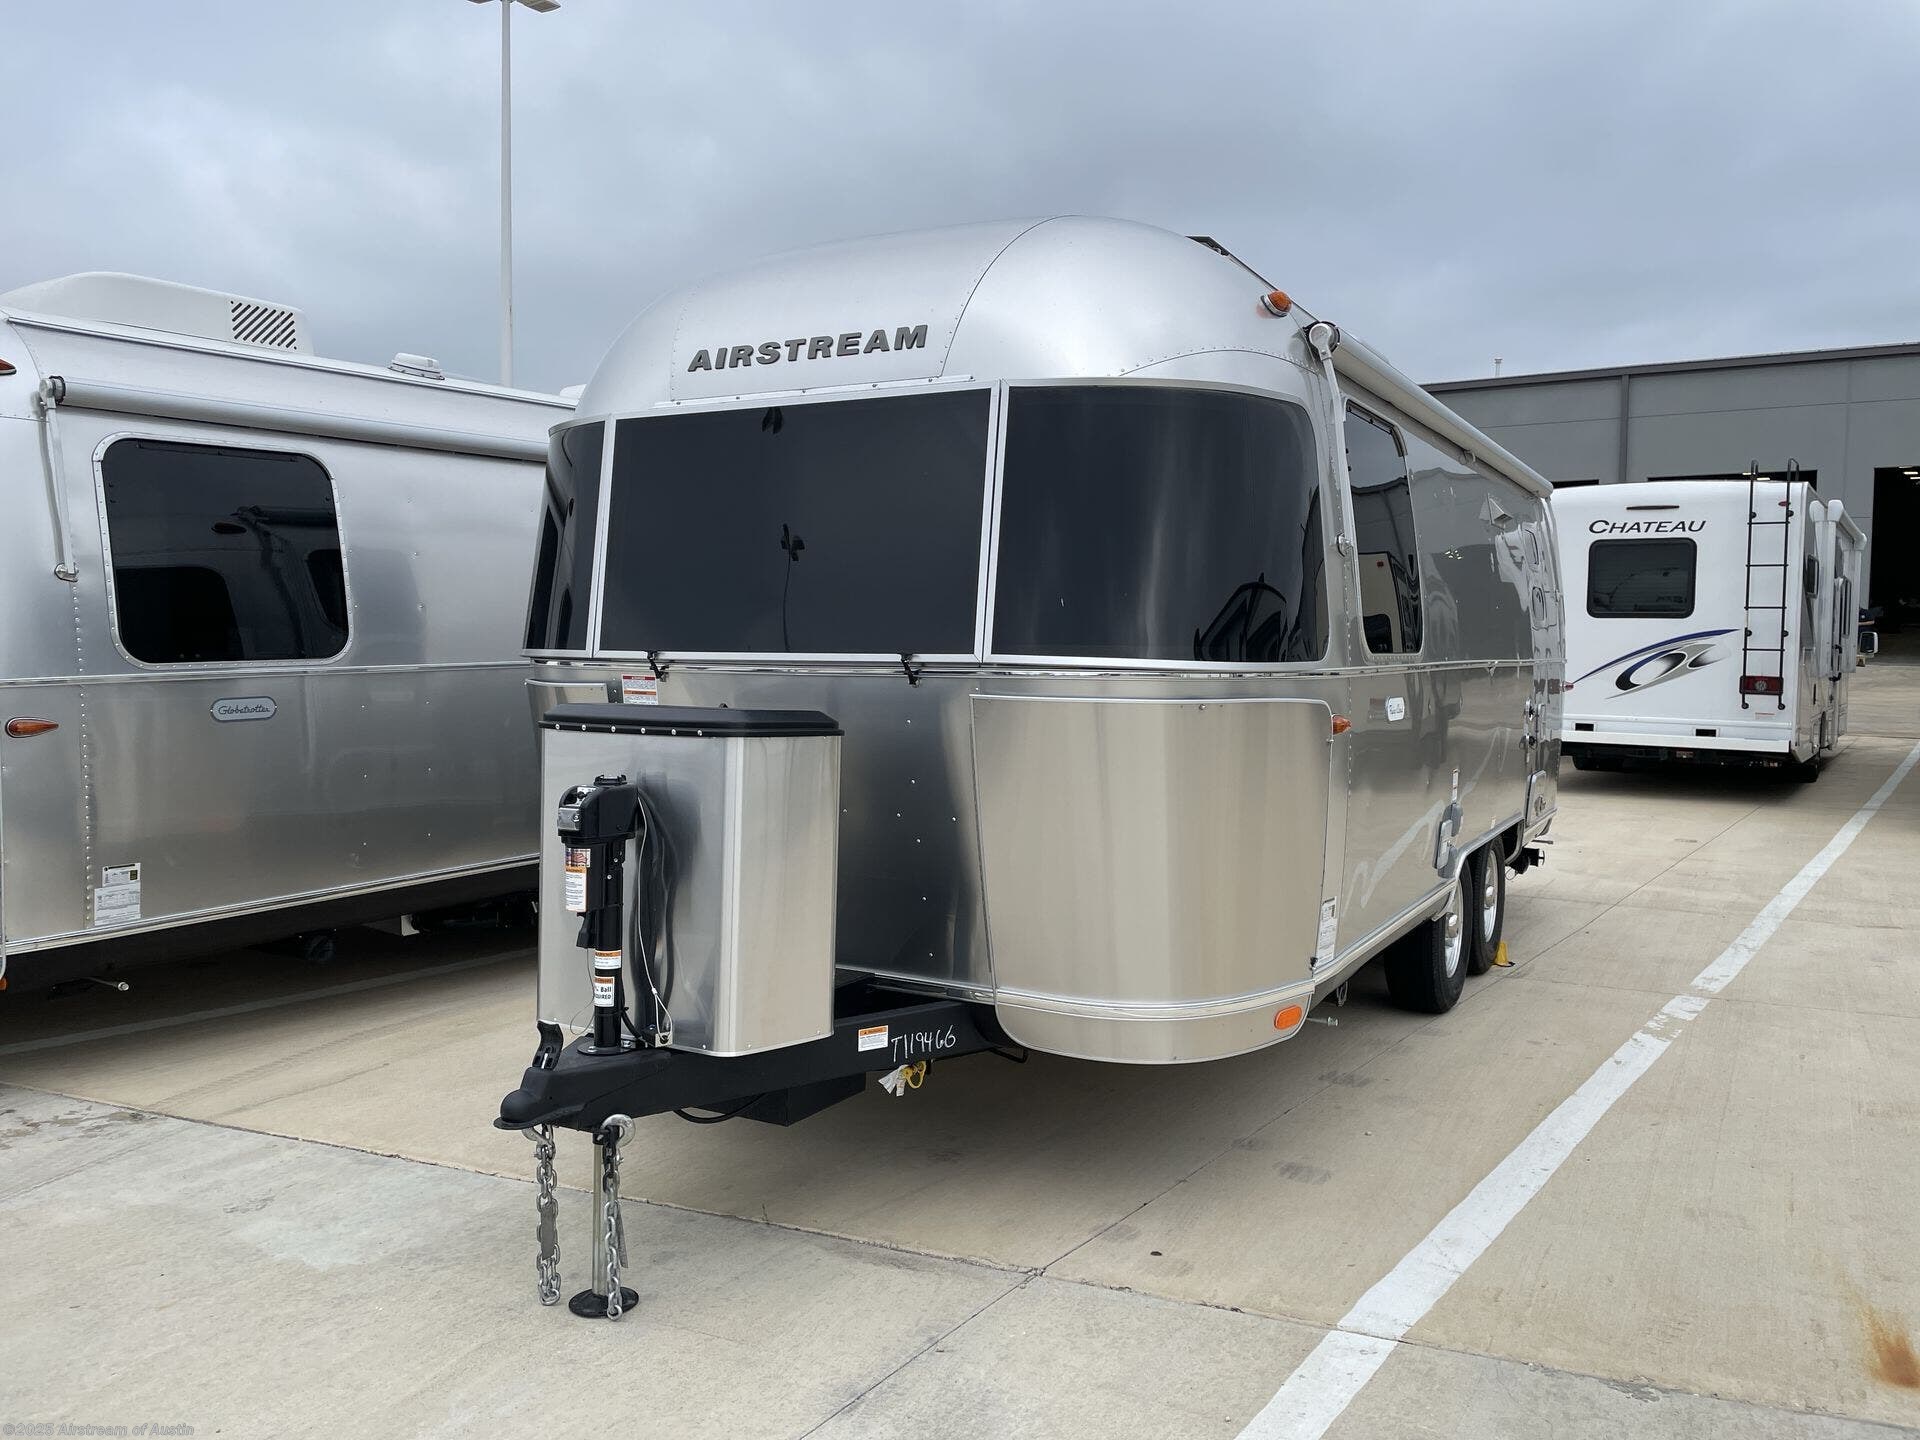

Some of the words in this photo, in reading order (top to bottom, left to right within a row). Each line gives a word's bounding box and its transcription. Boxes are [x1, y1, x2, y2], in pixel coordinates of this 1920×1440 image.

[687, 324, 929, 373] AIRSTREAM
[1588, 519, 1707, 534] CHATEAU
[891, 1024, 957, 1062] T119466
